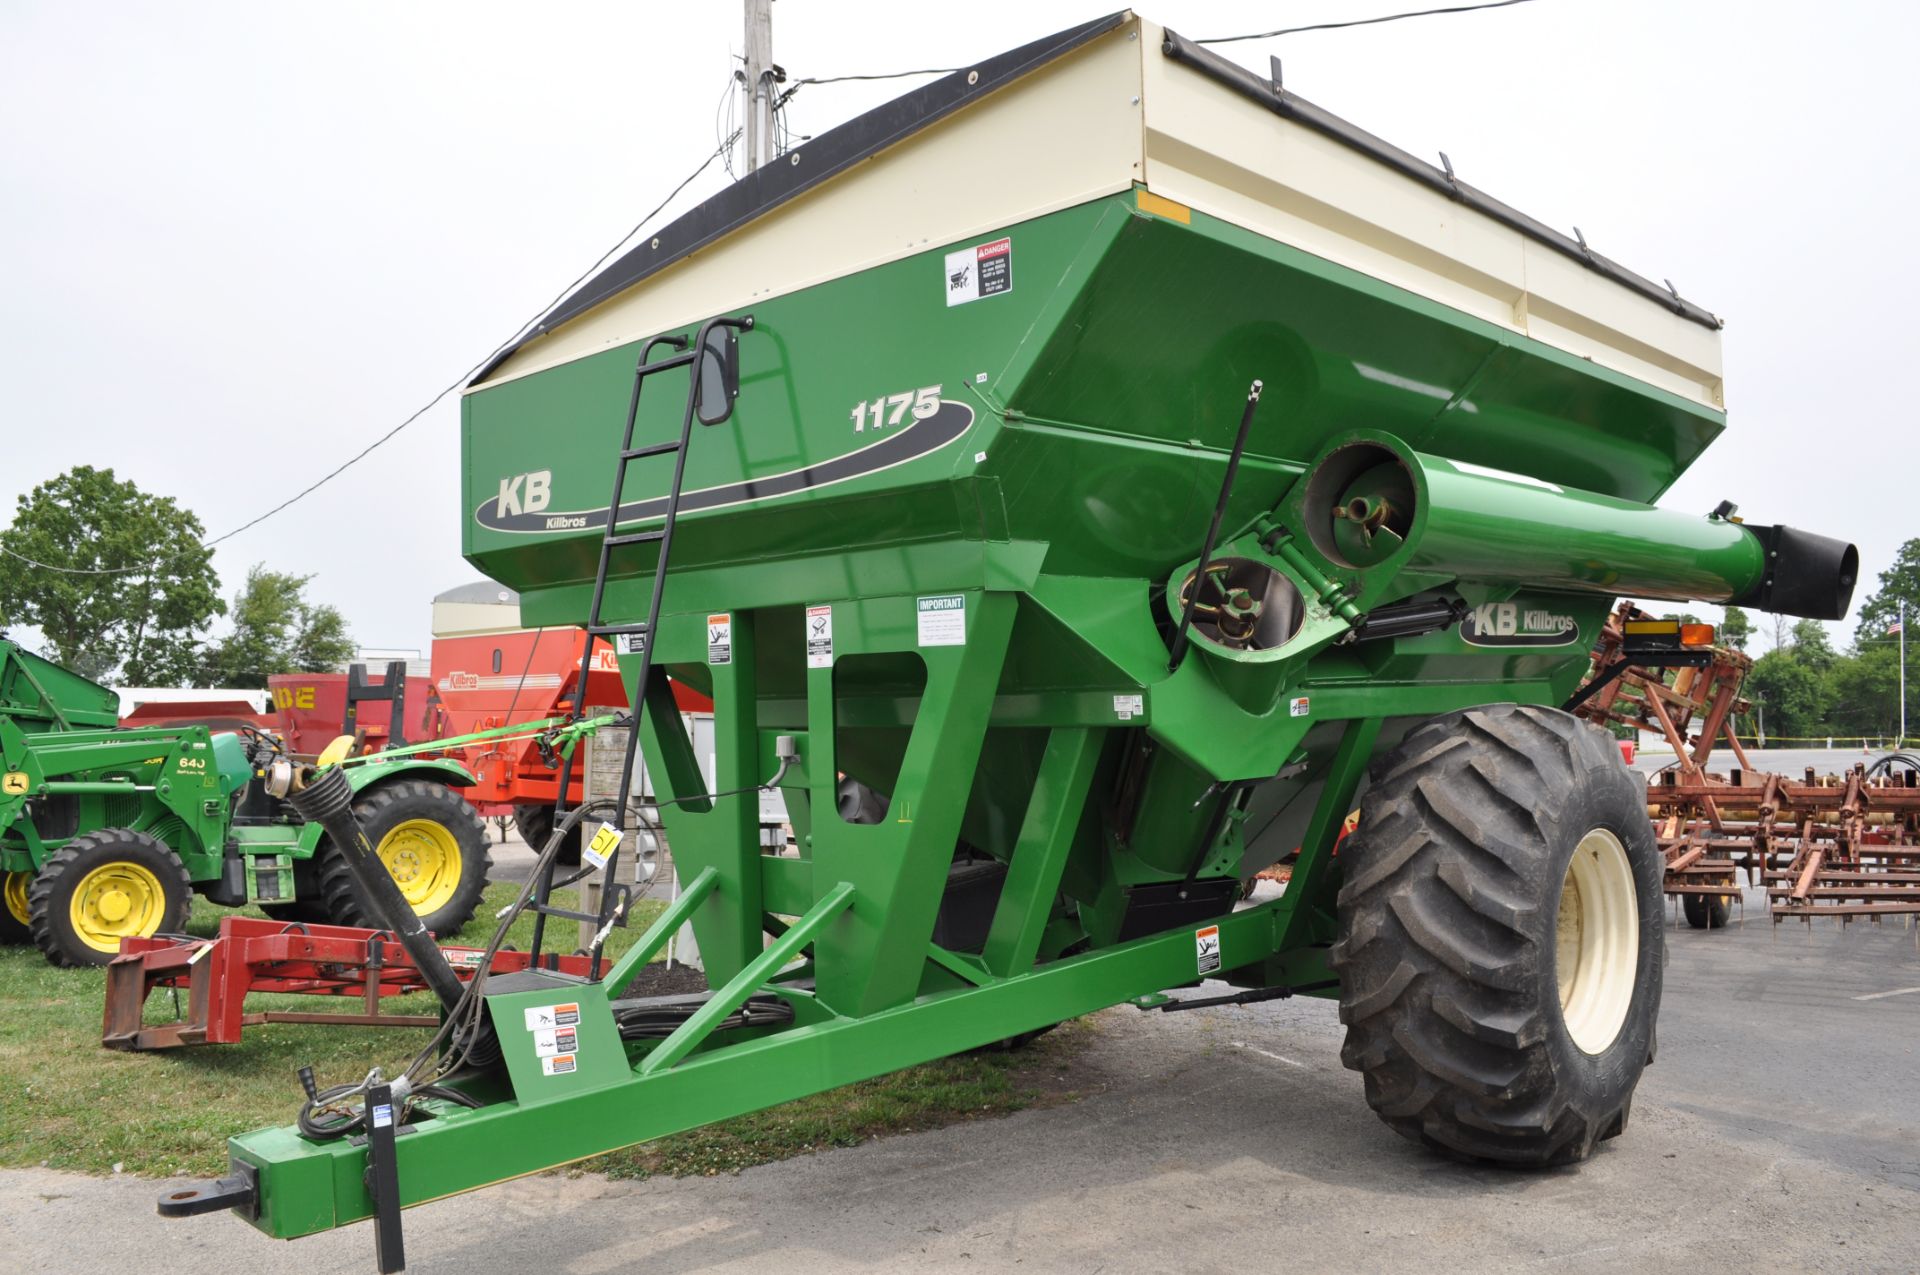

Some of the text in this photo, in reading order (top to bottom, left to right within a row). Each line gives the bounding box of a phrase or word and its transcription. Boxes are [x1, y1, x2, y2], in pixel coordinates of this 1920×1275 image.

[984, 242, 1009, 256] DANGER
[850, 384, 942, 434] 1175
[497, 470, 551, 519] KB
[546, 516, 587, 529] Killbros
[919, 598, 962, 611] IMPORTANT
[1474, 602, 1574, 636] KB Killbros
[449, 673, 478, 689] Killbros
[590, 827, 616, 856] 51
